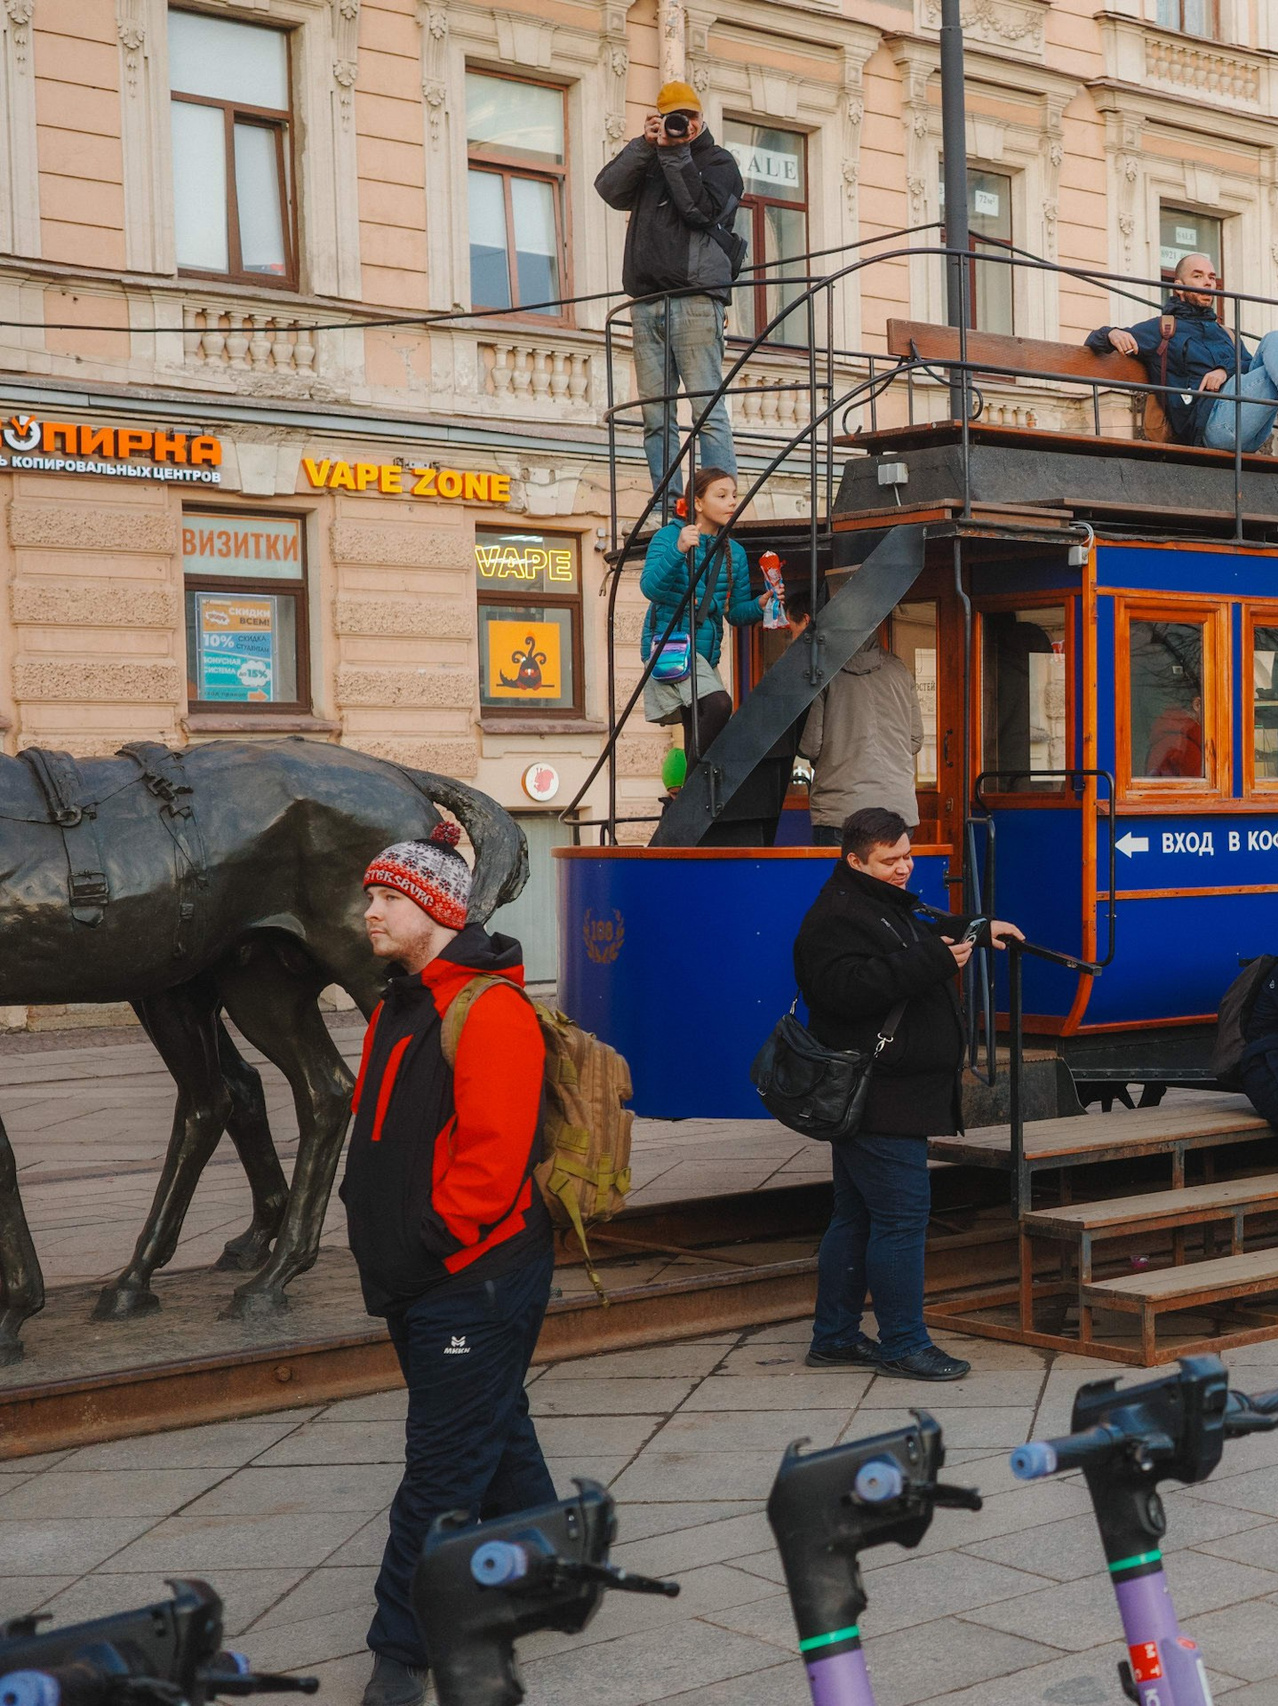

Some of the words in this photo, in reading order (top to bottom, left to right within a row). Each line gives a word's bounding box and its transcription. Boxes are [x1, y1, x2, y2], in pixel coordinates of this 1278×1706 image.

[0, 415, 222, 466] ОПИРКА
[12, 456, 151, 479] КОПИРОВАЛЬНЫХ
[153, 467, 221, 483] ЦЕНТРОВ
[303, 458, 402, 494] VAPE
[411, 467, 511, 502] ZONE
[182, 528, 299, 562] ВИЗИТКИ
[475, 545, 573, 582] VAPE
[229, 607, 271, 617] СКИДКИ
[240, 617, 270, 627] ВСЕМ!
[203, 634, 235, 648] 10%
[247, 669, 268, 678] 15%
[1162, 832, 1214, 856] ВХОД
[1229, 831, 1241, 852] В
[591, 920, 613, 942] 108
